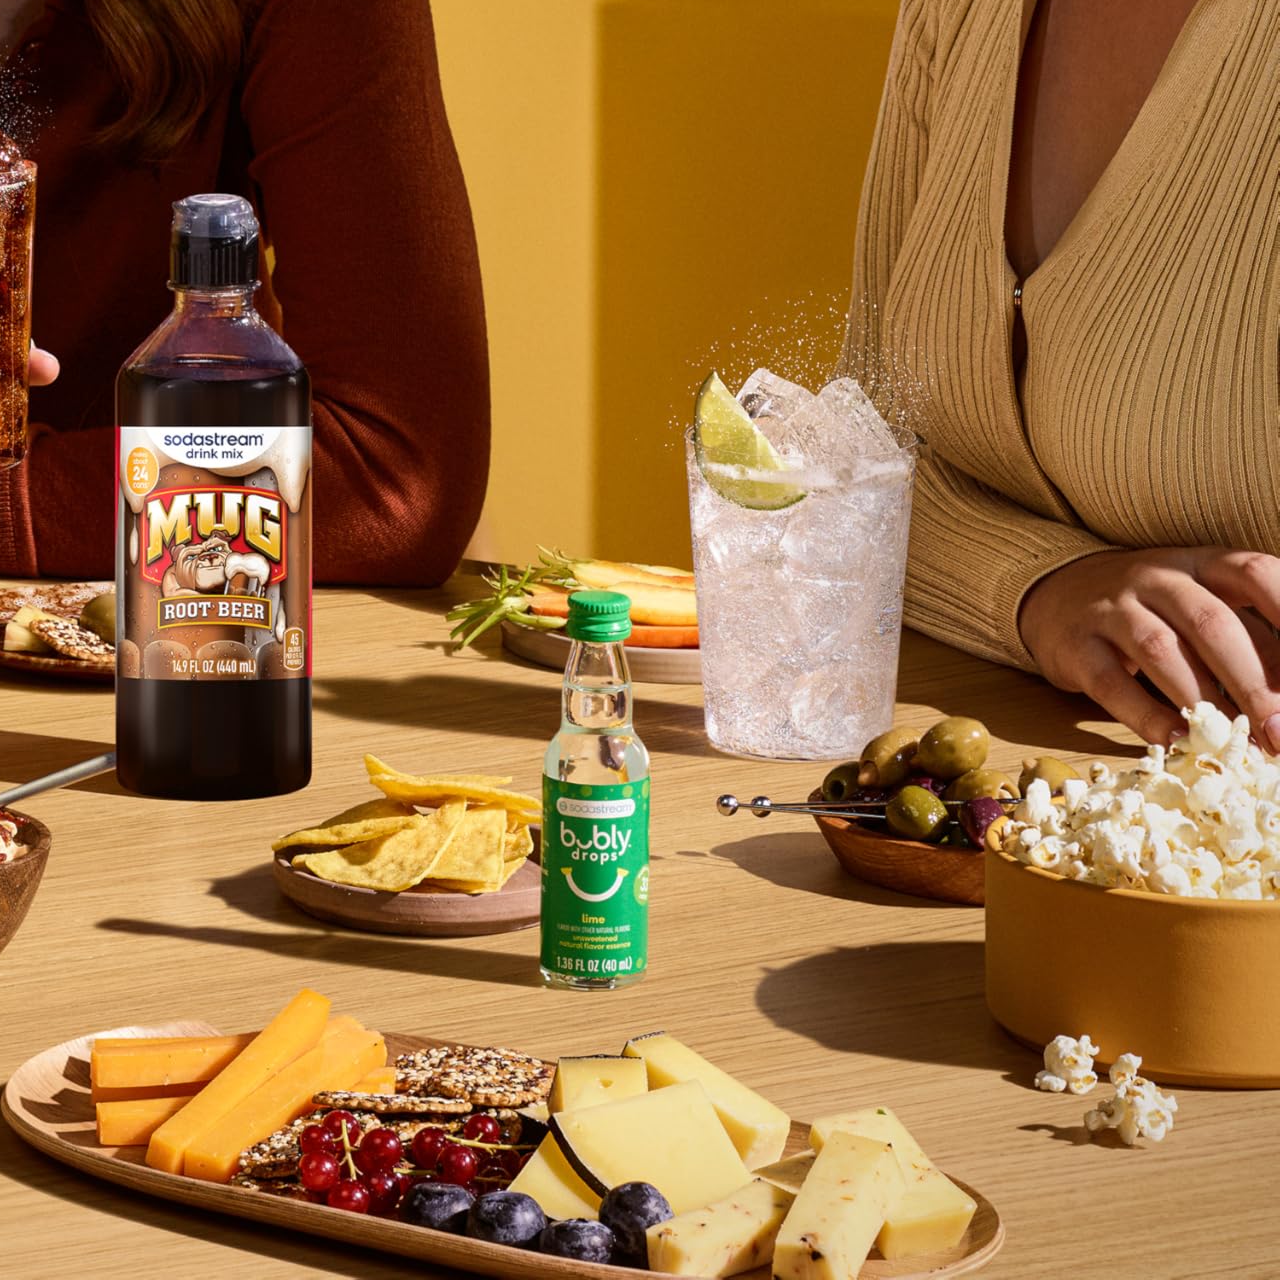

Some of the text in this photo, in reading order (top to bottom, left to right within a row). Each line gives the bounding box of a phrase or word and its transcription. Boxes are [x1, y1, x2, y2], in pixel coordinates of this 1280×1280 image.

[164, 433, 263, 447] sodastream
[186, 448, 243, 459] drink mix
[133, 466, 149, 481] 24
[147, 492, 281, 565] MUG
[164, 601, 265, 620] ROOT BEER
[290, 633, 299, 646] 45
[172, 659, 256, 674] 14.9 FL OZ (440 mL)
[569, 804, 632, 814] sodastream
[560, 821, 632, 856] bubly
[571, 848, 618, 866] drops
[582, 913, 605, 924] lime
[584, 942, 605, 950] flavor
[557, 956, 632, 973] 1.36 FL OZ (40 mL)
